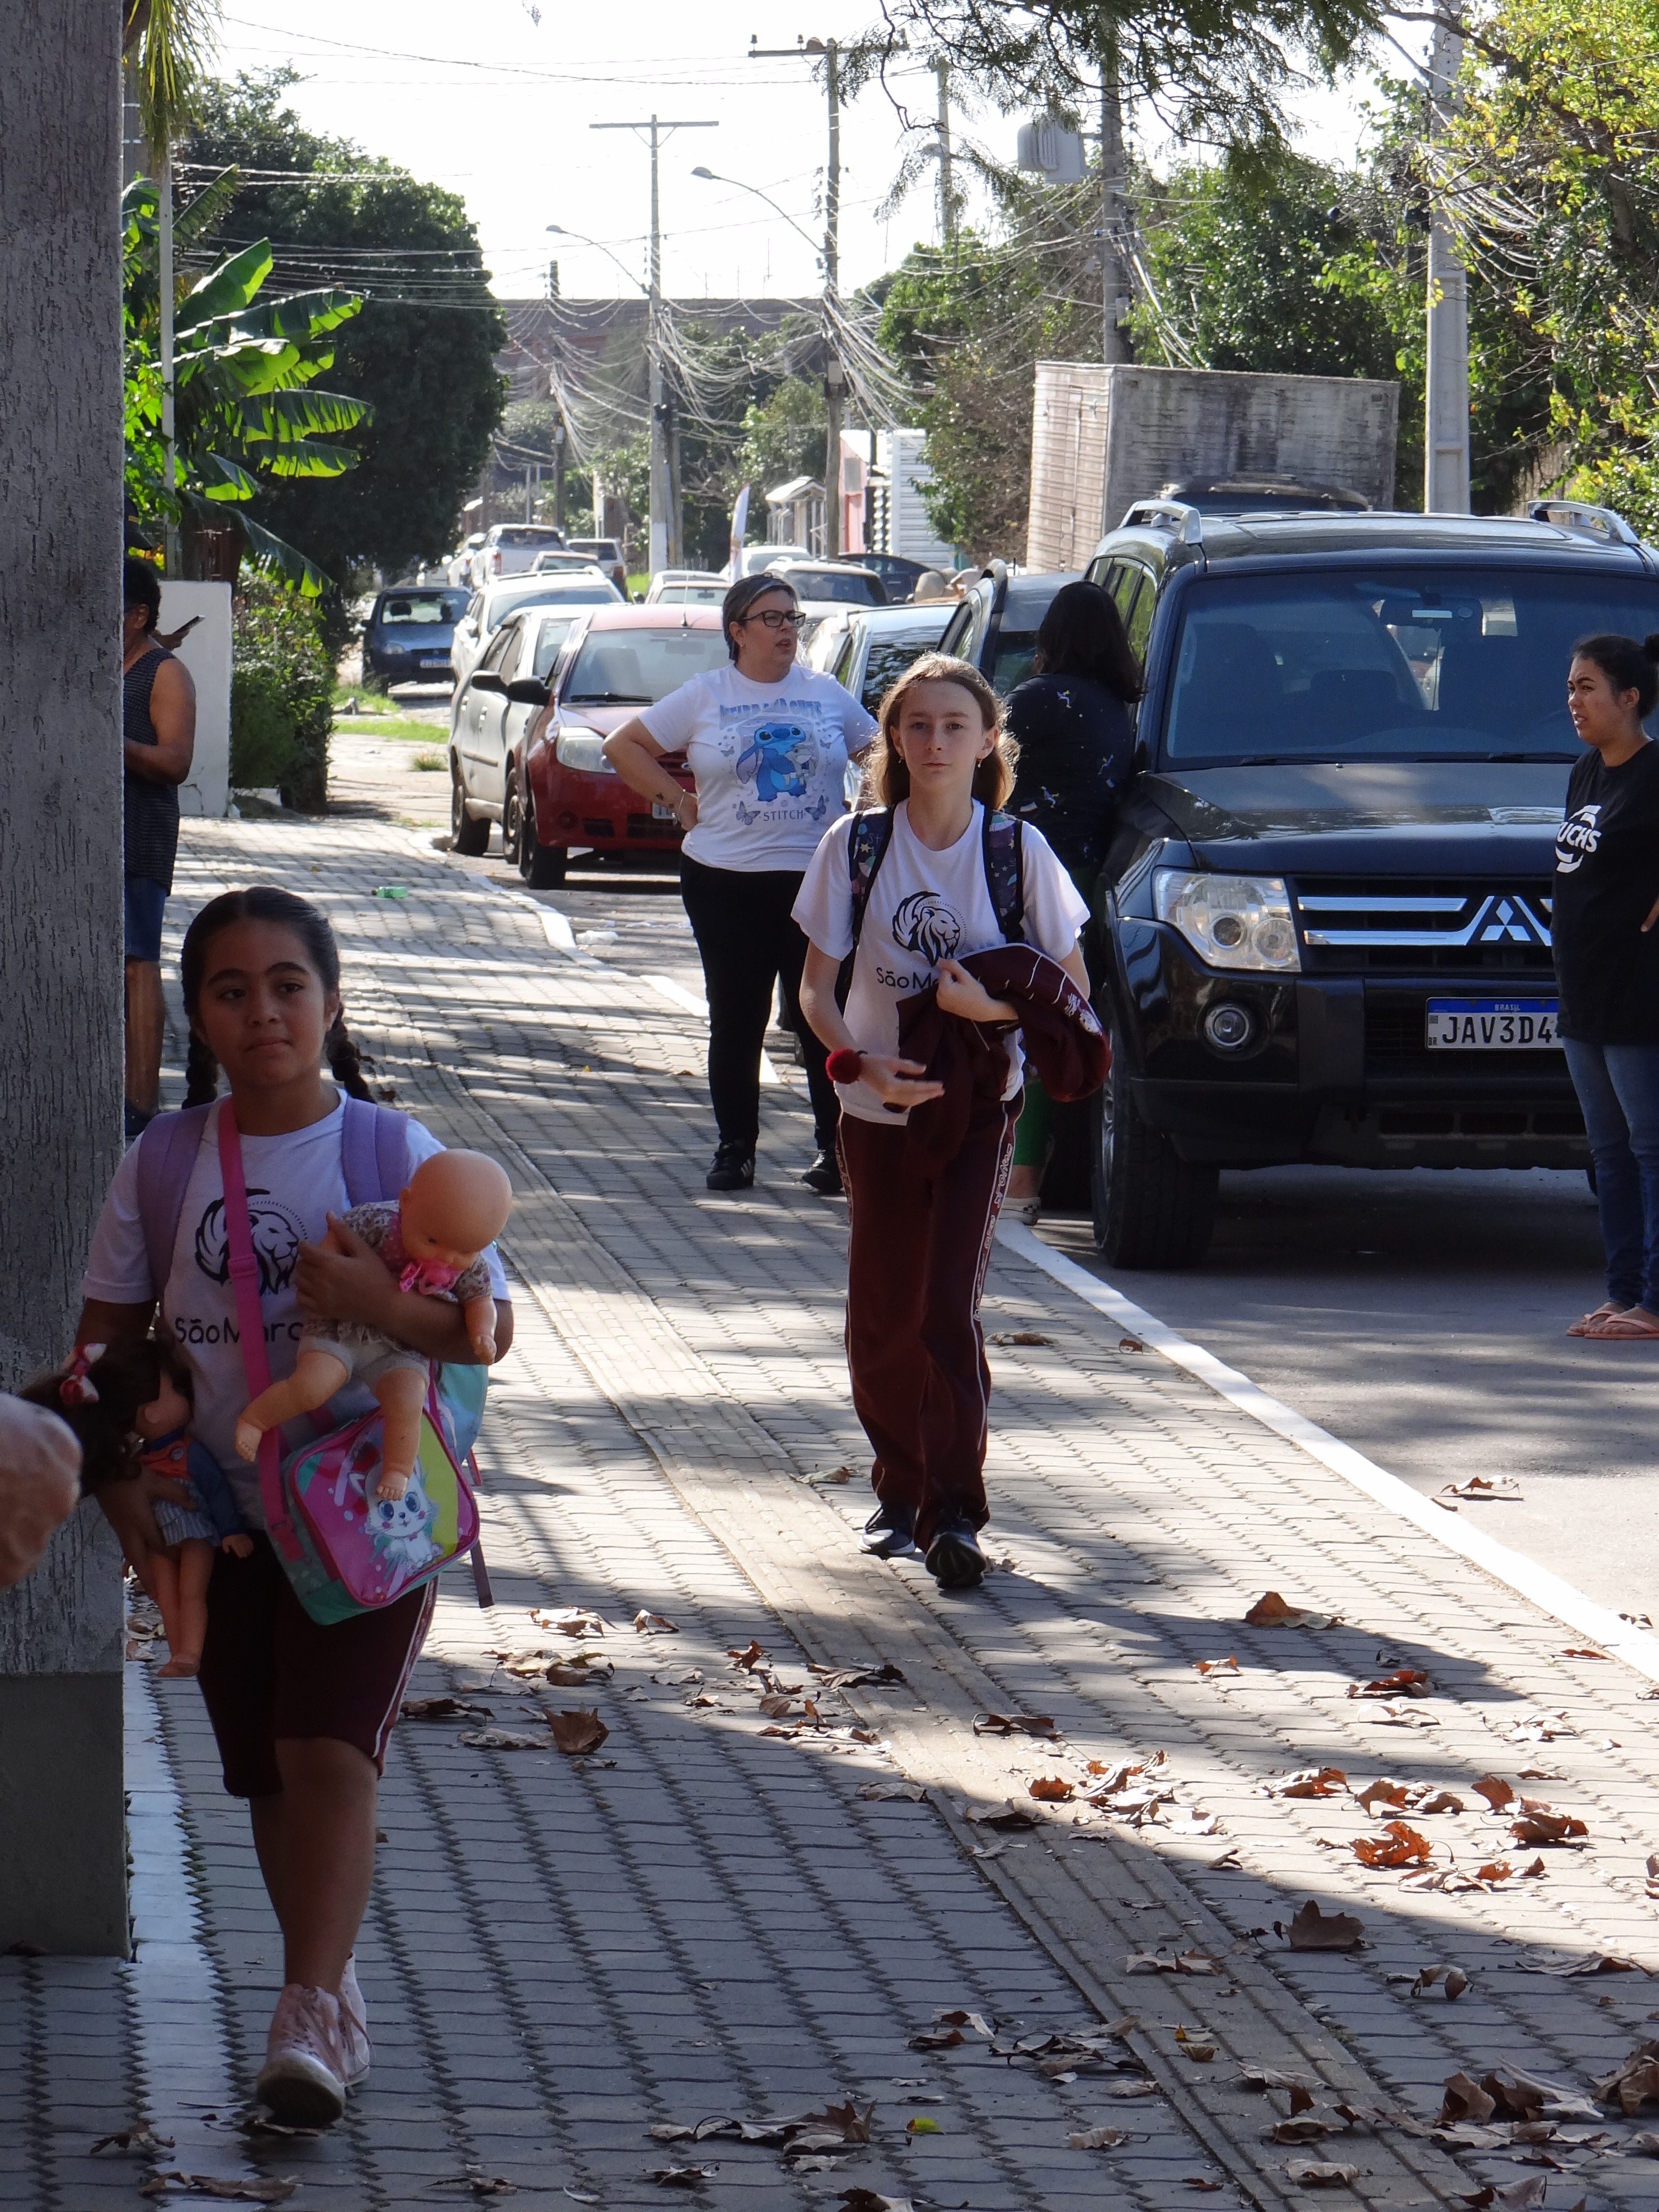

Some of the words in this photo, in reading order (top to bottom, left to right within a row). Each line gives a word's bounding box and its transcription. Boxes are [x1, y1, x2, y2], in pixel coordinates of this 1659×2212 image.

[763, 810, 803, 821] STITCH
[1557, 821, 1602, 853] UCHS
[1442, 1016, 1560, 1044] JAV3D4
[175, 1316, 304, 1344] SãoMrc
